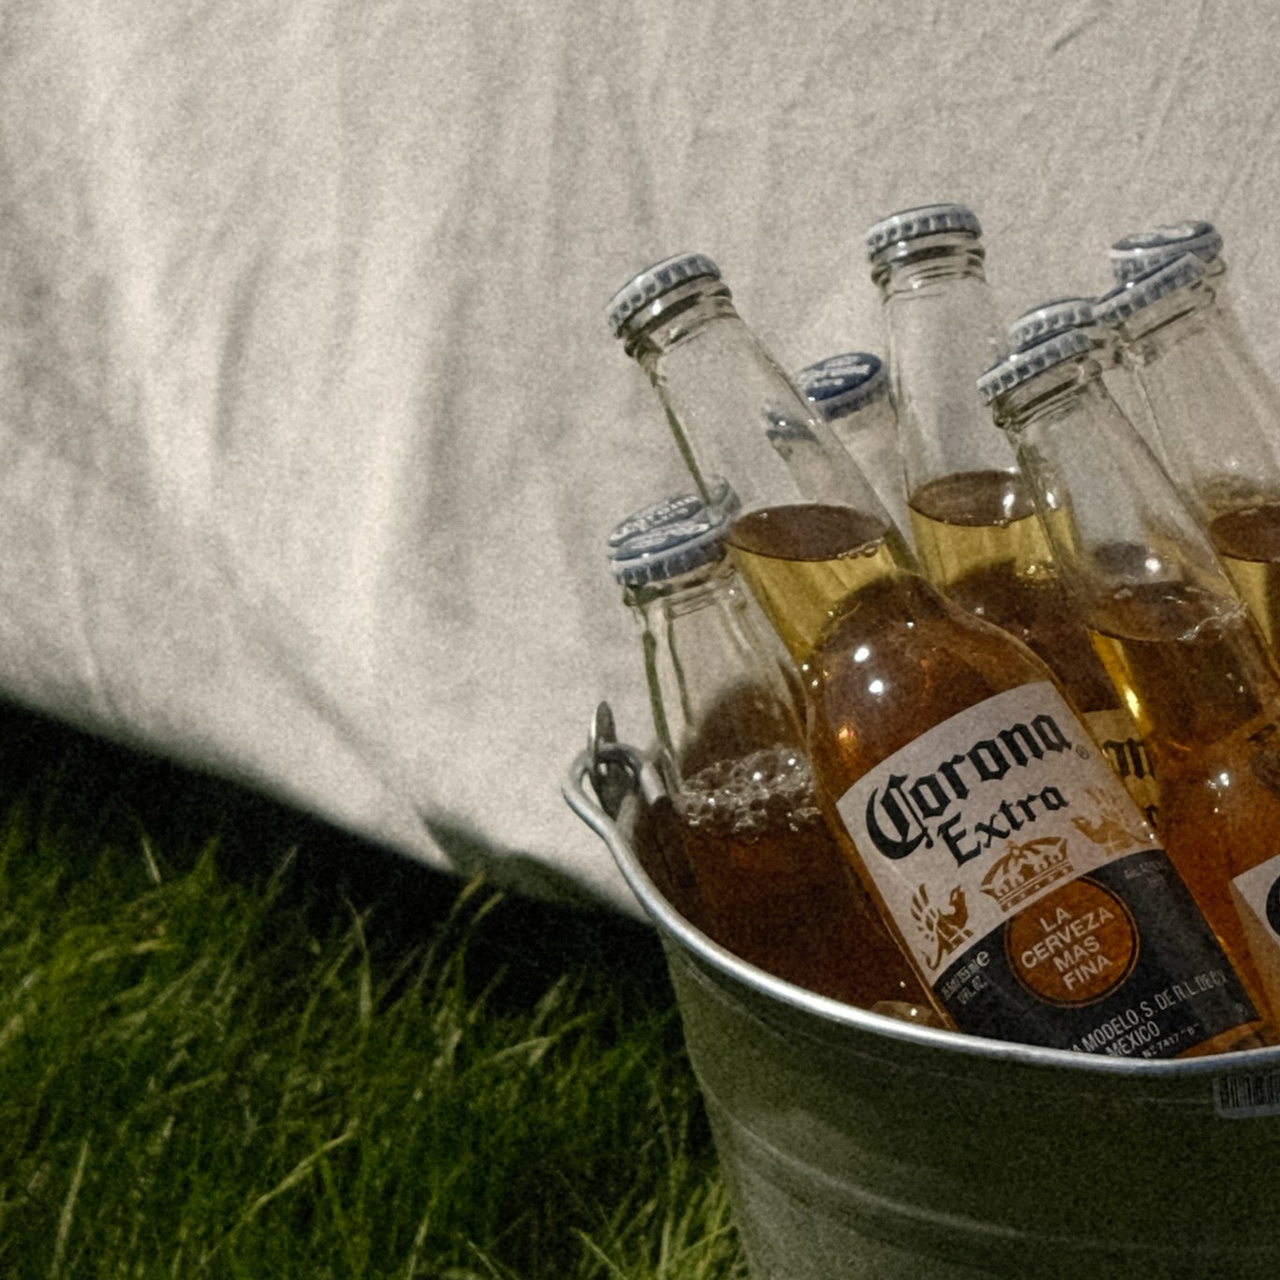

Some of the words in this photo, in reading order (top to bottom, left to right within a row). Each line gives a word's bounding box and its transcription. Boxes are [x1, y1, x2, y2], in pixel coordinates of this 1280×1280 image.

[866, 714, 1073, 860] Corona
[937, 786, 1070, 868] Extra
[1020, 906, 1116, 969] CERVEZA
[1040, 906, 1072, 933] LA
[1052, 935, 1100, 973] MAS
[1062, 954, 1114, 992] FINA
[1154, 989, 1176, 1010] DE
[1105, 1020, 1160, 1058] MEXICO
